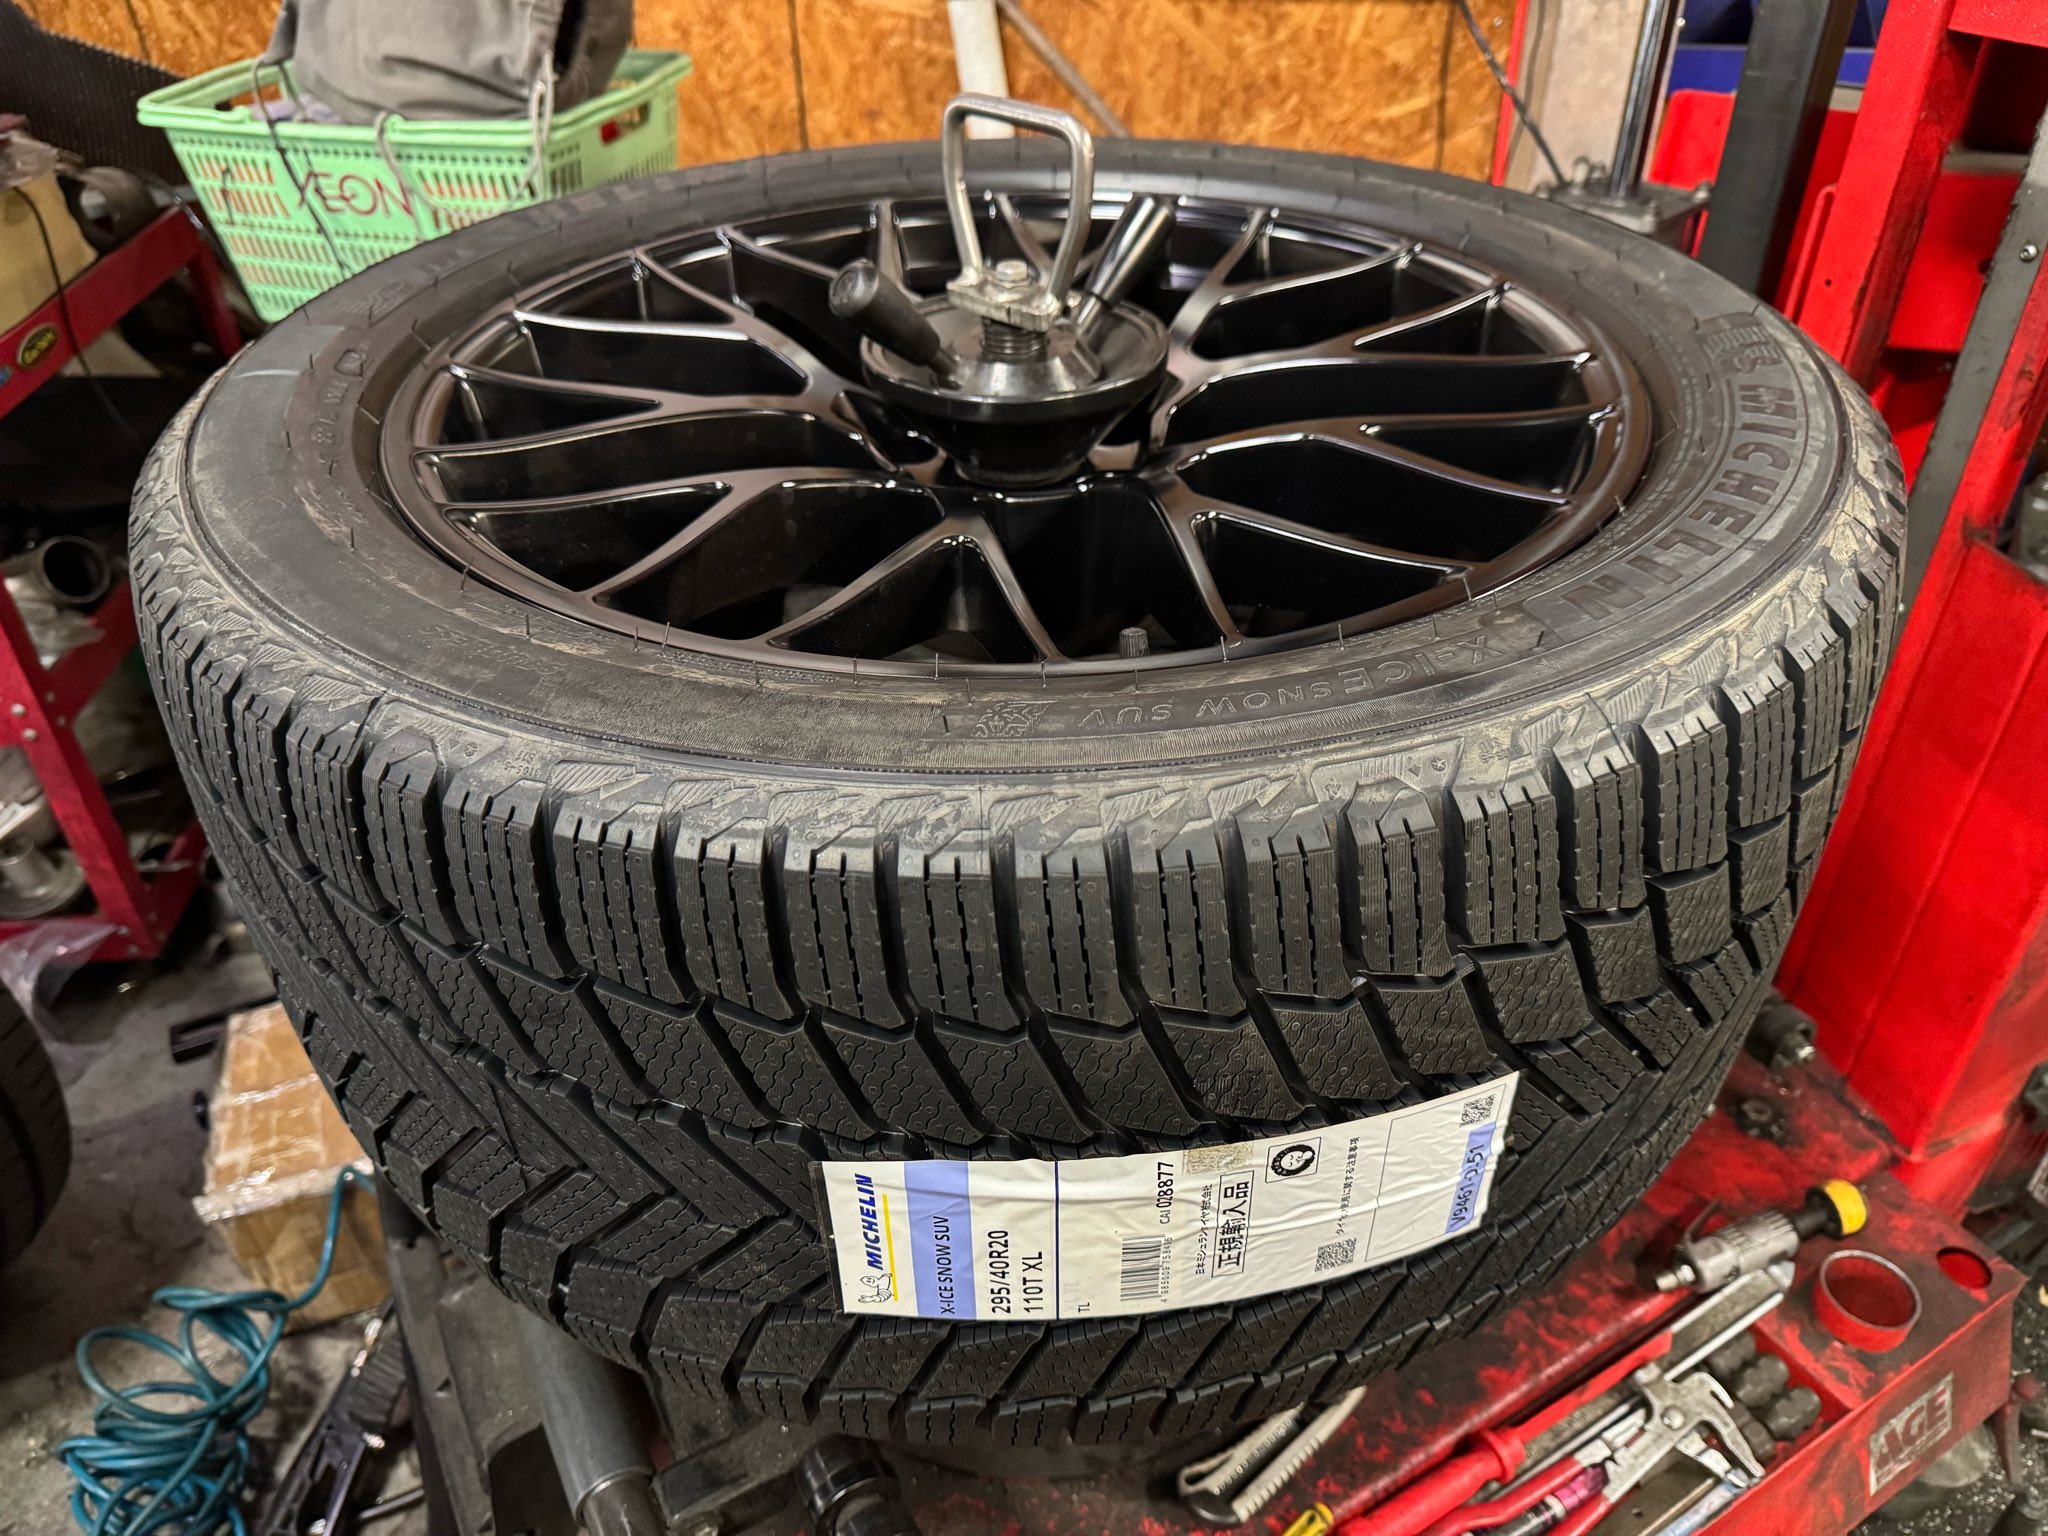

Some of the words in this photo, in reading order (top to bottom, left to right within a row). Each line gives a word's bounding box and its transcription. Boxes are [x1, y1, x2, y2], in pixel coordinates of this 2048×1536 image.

[1560, 384, 1798, 621] MICHELIN
[1338, 635, 1502, 694] X-ICE
[1077, 704, 1174, 728] SUV
[1196, 680, 1331, 718] SNOW
[1156, 1162, 1174, 1209] 028877
[854, 1173, 883, 1271] MICHELIN
[933, 1216, 951, 1242] SUV
[1160, 1210, 1170, 1224] CAI
[1217, 1181, 1250, 1269] 正規輸入品
[936, 1244, 954, 1283] SNOW
[987, 1230, 1011, 1314] 295/40R20
[1021, 1251, 1043, 1272] XL
[938, 1285, 955, 1314] X-ICE
[1022, 1276, 1043, 1313] 110T
[1078, 1302, 1090, 1313] TL
